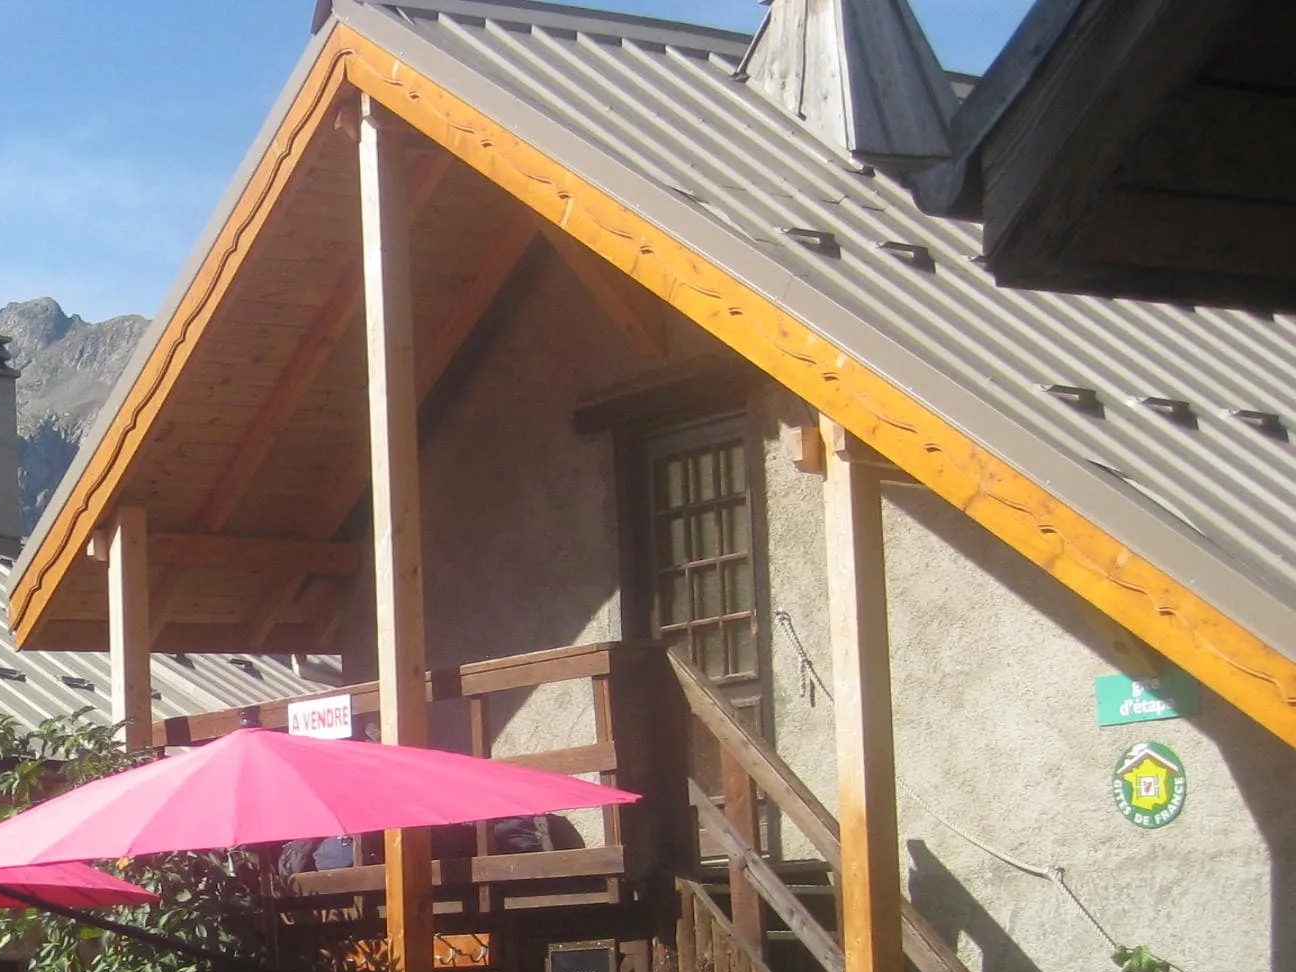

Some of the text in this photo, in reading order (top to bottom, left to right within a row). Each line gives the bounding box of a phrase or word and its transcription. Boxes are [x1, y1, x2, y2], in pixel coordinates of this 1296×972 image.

[292, 706, 348, 732] A VENDRE
[1133, 812, 1151, 826] DE
[1153, 776, 1185, 825] FRANCE
